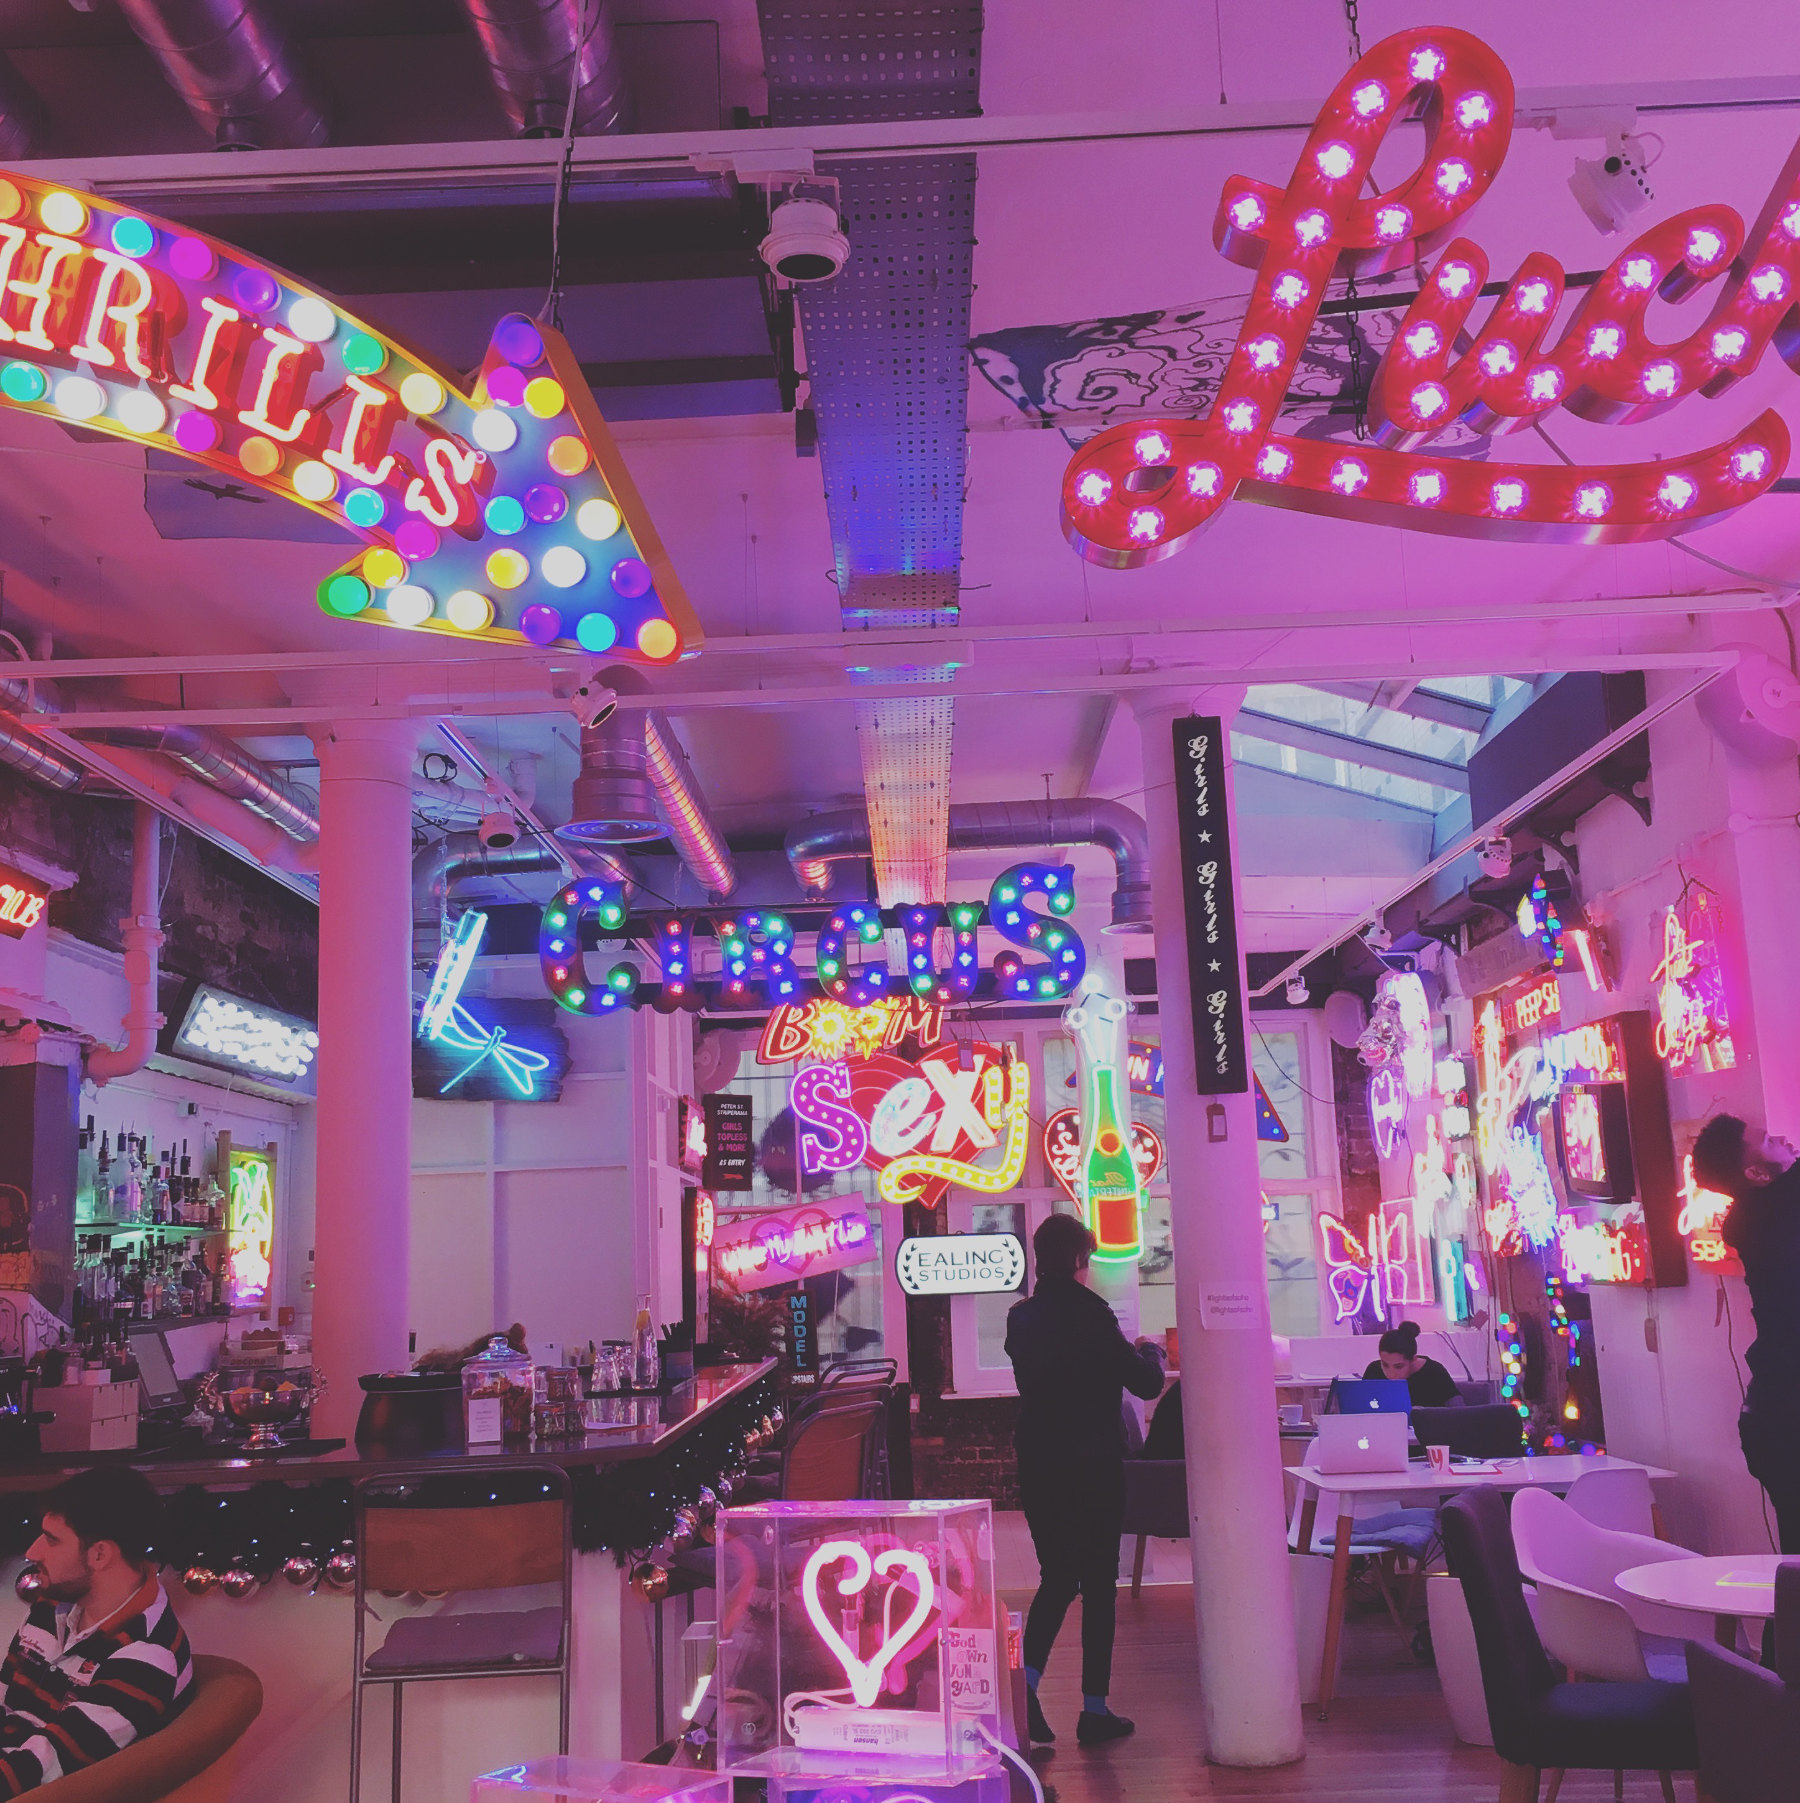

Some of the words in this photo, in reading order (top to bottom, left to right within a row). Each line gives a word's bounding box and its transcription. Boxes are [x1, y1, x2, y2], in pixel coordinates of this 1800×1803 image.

[1188, 735, 1208, 817] Girls
[1197, 861, 1219, 943] Girls
[540, 862, 1087, 1016] CIRCUS
[757, 995, 945, 1065] BOOM
[1207, 989, 1229, 1075] Girls
[717, 1133, 748, 1141] TOPLESS
[721, 1122, 743, 1131] GIRLS
[726, 1143, 747, 1152] MORE
[727, 1159, 746, 1167] ENTRY
[918, 1249, 1004, 1267] EALING
[918, 1266, 1005, 1282] STUDIOS
[790, 1295, 807, 1367] MODEL
